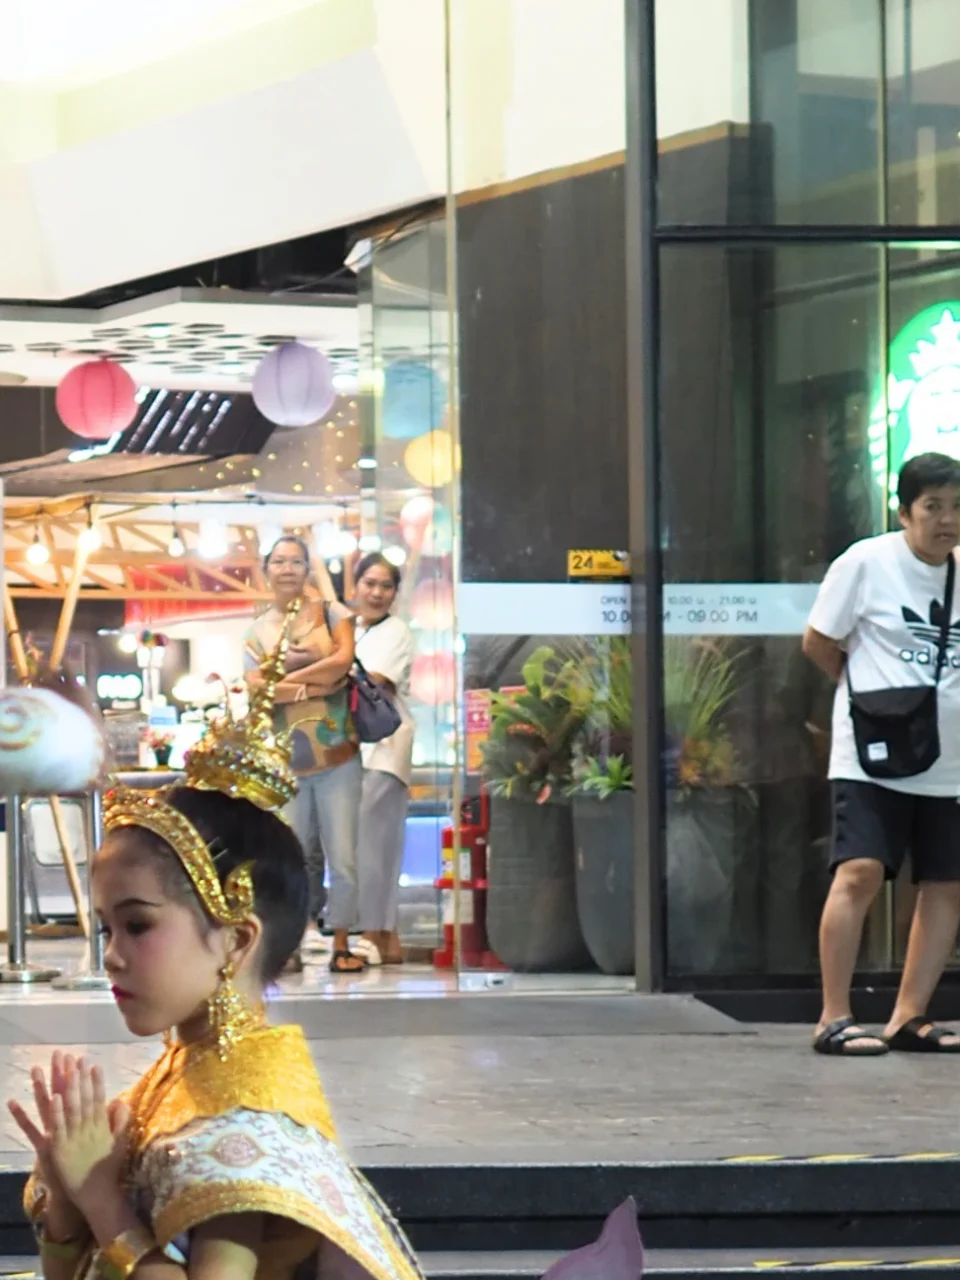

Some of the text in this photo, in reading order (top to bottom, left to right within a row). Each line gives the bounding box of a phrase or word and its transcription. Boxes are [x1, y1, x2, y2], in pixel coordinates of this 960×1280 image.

[572, 555, 593, 570] 24
[602, 610, 631, 622] 10.0
[687, 609, 730, 623] 09.00
[735, 610, 758, 622] PM
